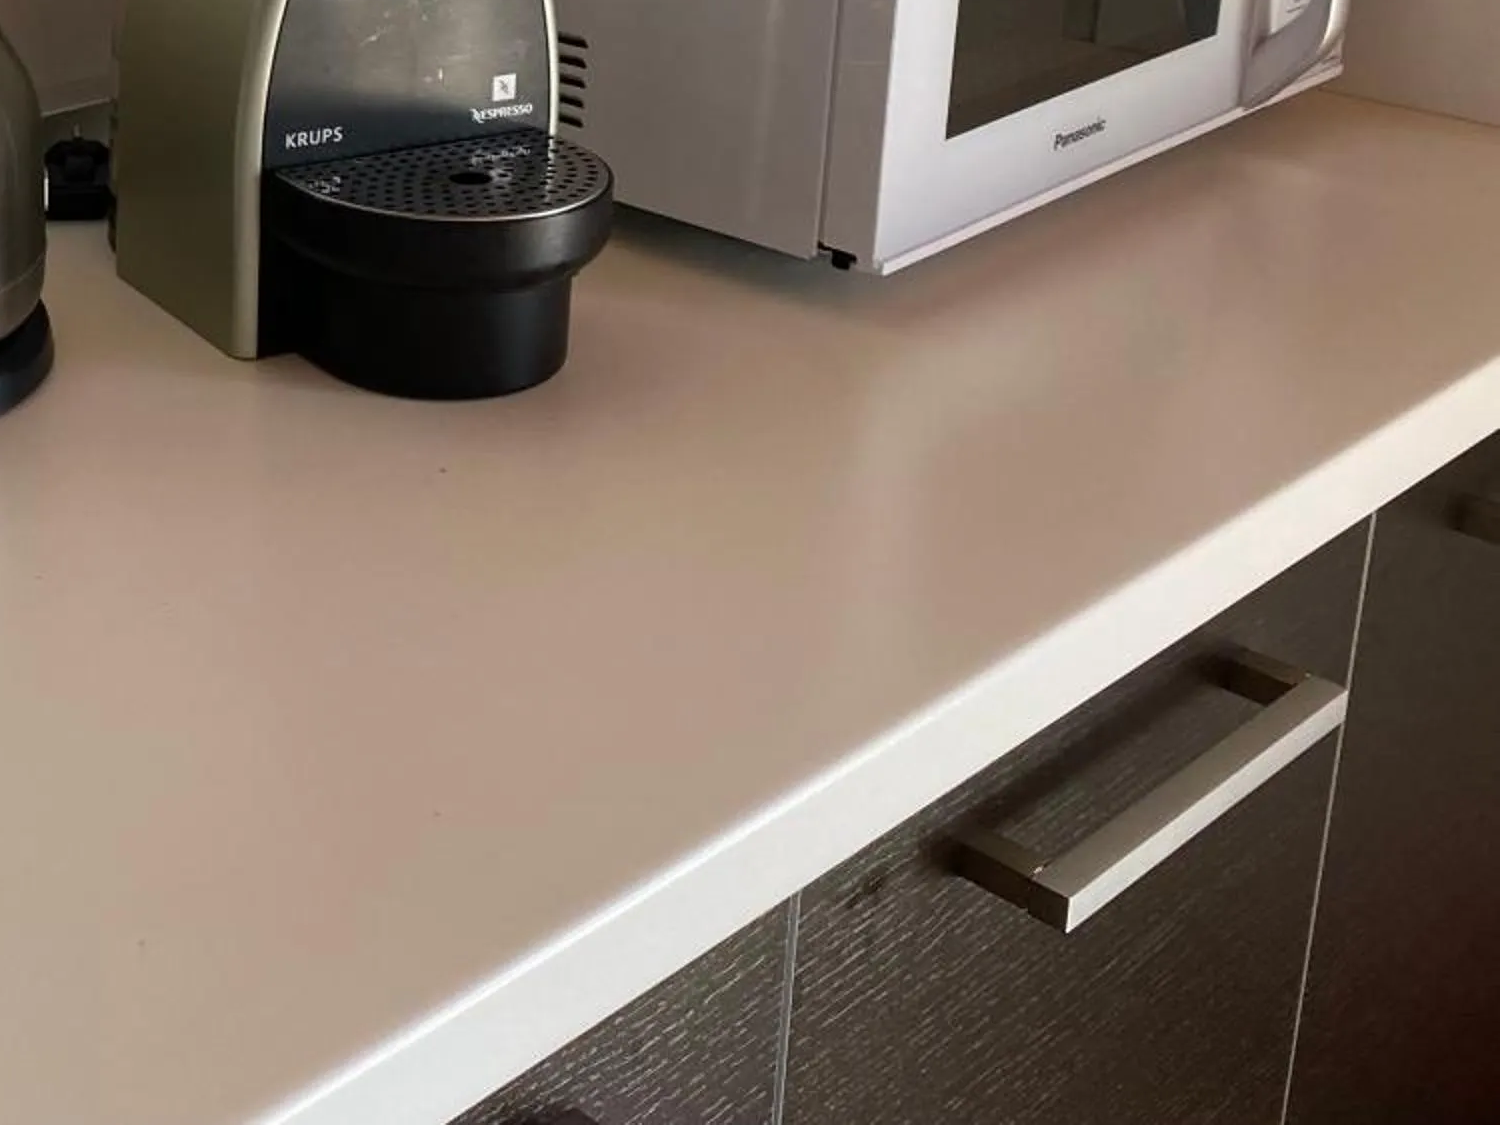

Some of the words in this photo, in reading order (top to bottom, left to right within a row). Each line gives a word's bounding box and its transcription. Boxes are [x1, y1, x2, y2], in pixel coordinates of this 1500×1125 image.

[469, 103, 533, 124] NESPRESSO
[285, 126, 343, 150] KRUPS
[1053, 116, 1106, 151] Panasonic
